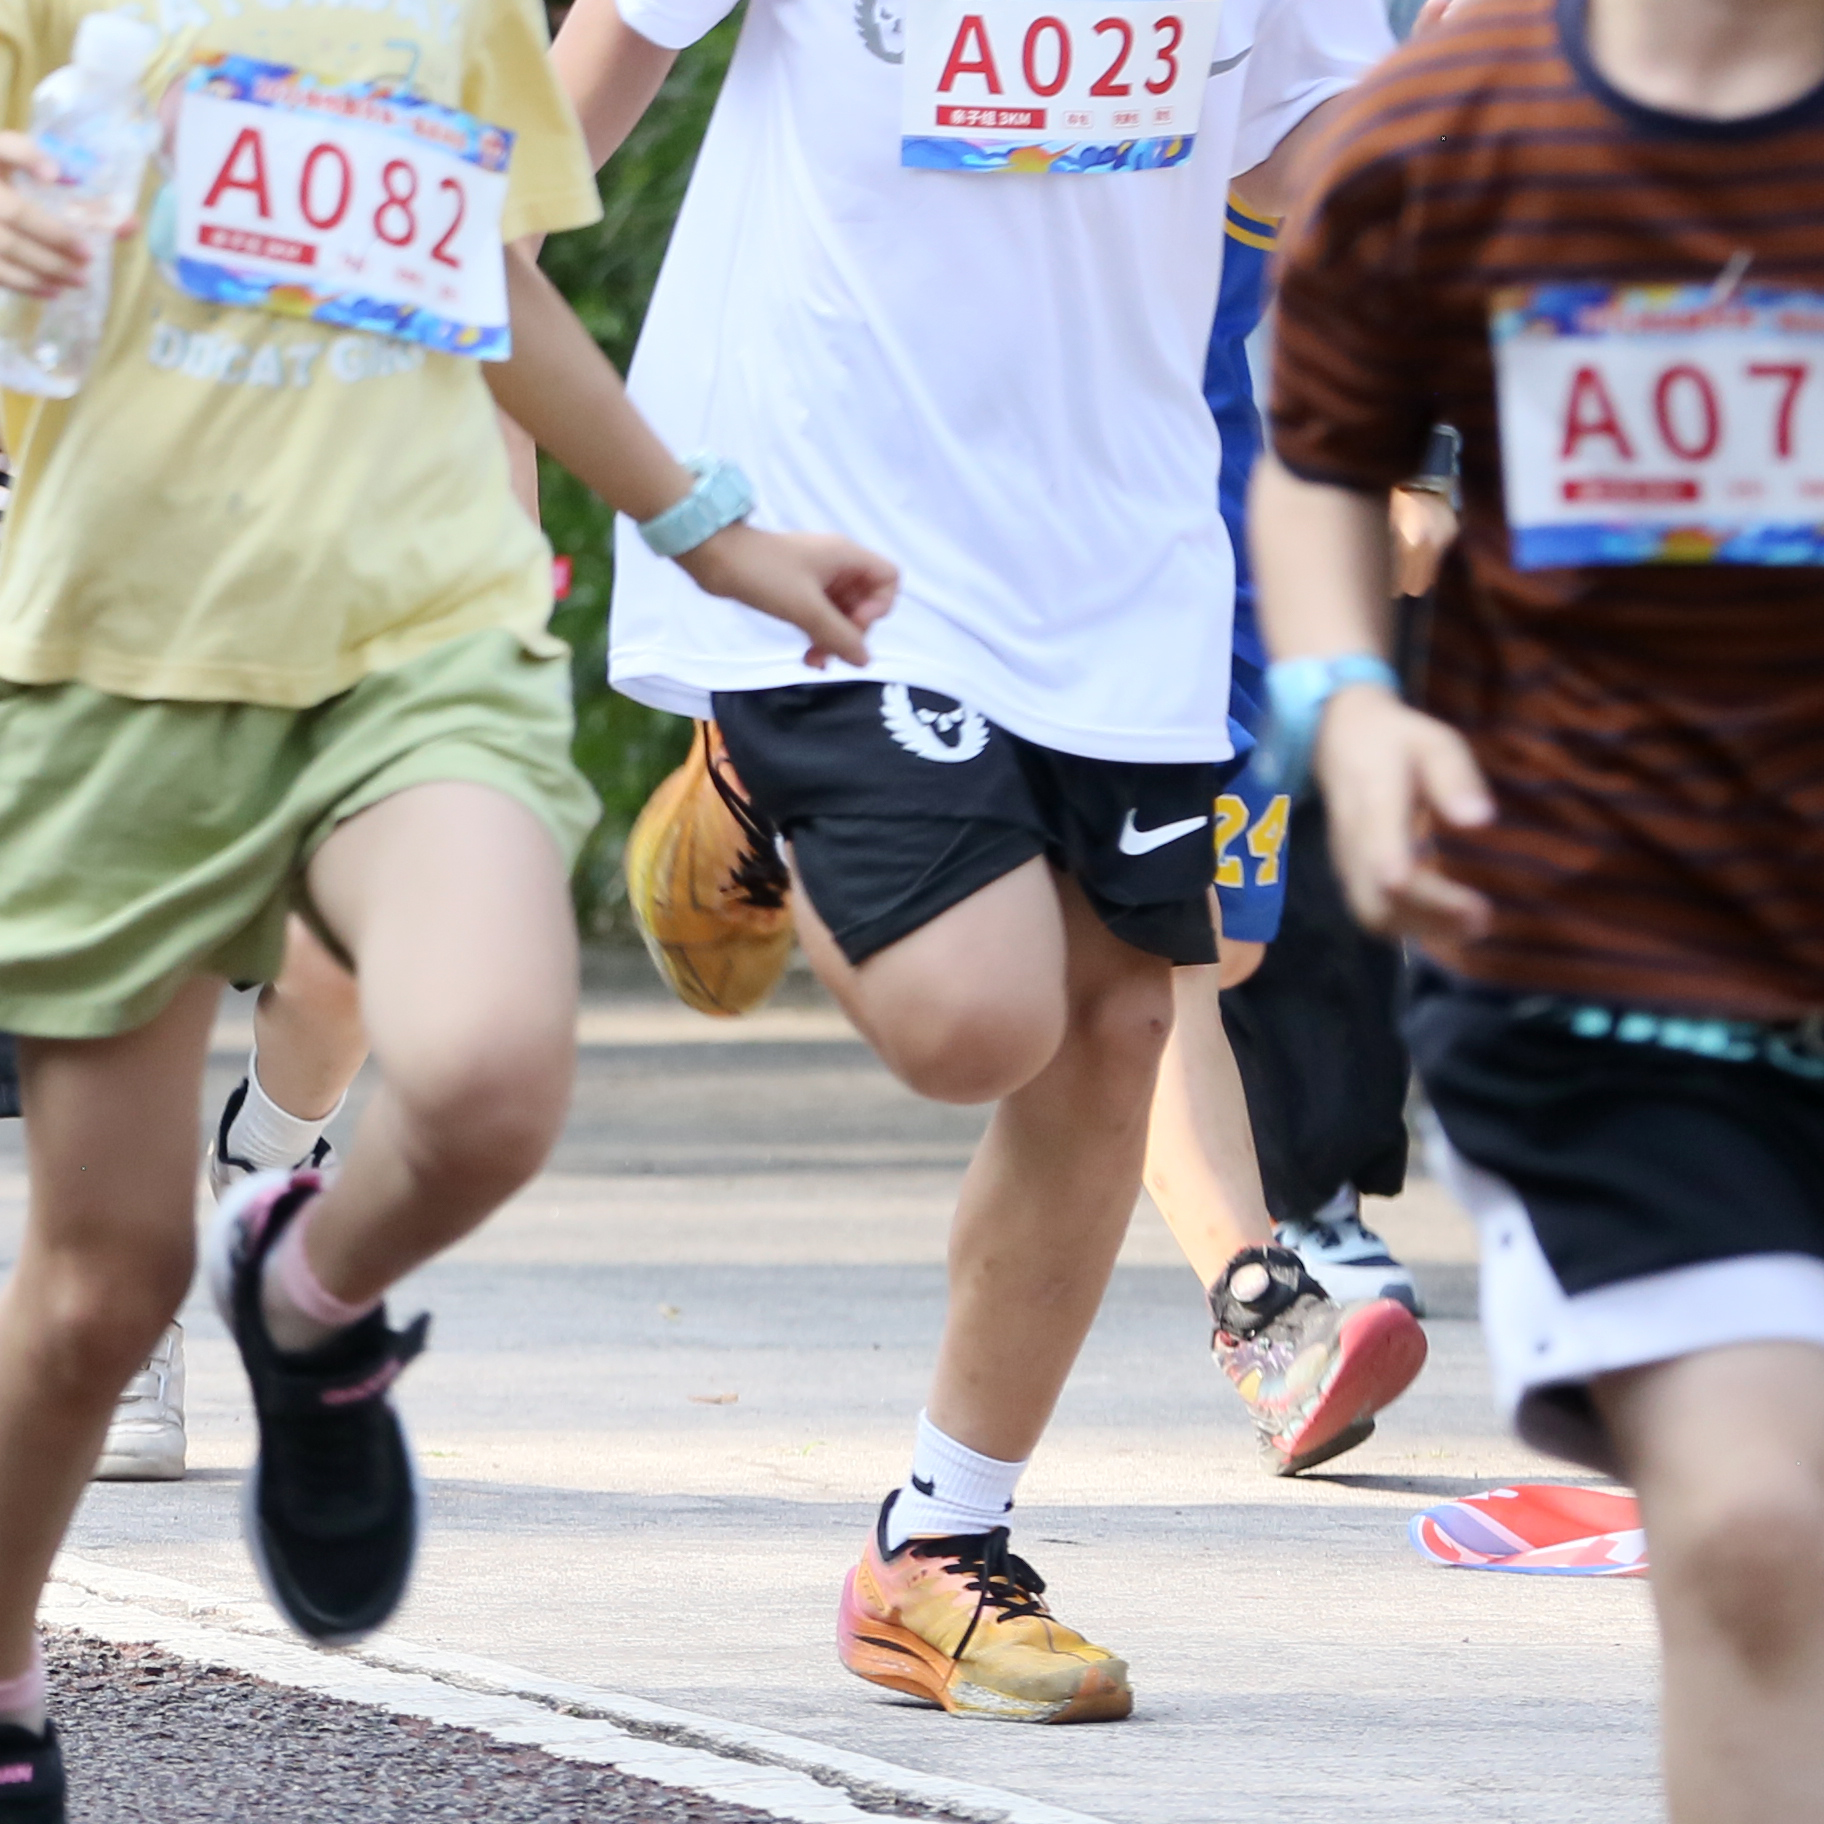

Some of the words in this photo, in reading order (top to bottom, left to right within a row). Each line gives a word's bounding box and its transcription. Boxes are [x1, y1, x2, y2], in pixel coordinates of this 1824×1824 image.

[936, 13, 1184, 98] A023
[203, 127, 465, 269] A082
[1559, 361, 1810, 463] A07
[1214, 793, 1292, 889] 24
